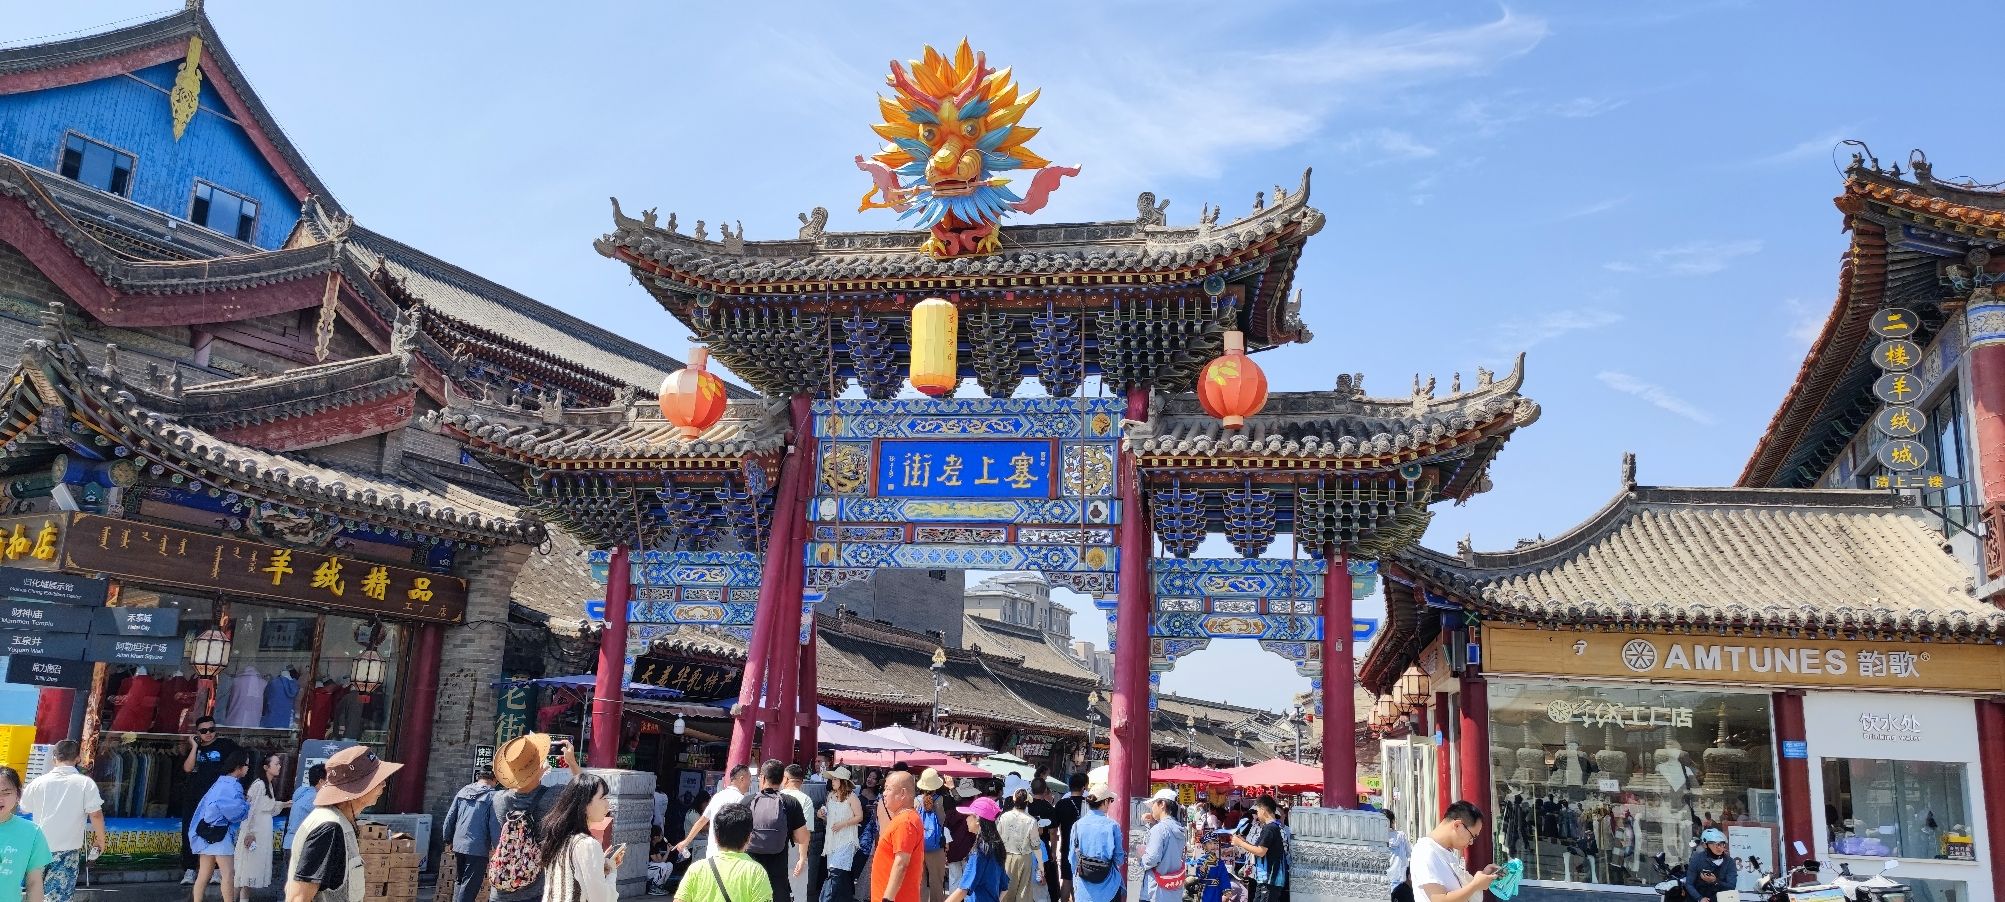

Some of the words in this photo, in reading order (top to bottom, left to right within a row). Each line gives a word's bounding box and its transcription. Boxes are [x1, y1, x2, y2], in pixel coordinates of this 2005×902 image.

[1883, 313, 1919, 467] 二楼羊绒城
[262, 548, 434, 601] 羊绒精品
[11, 607, 44, 619] 财神庙
[402, 602, 448, 617] 工厂店
[11, 635, 43, 646] 玉泉井
[1664, 644, 1848, 675] AMTUNES
[1859, 712, 1921, 733] 饮水处
